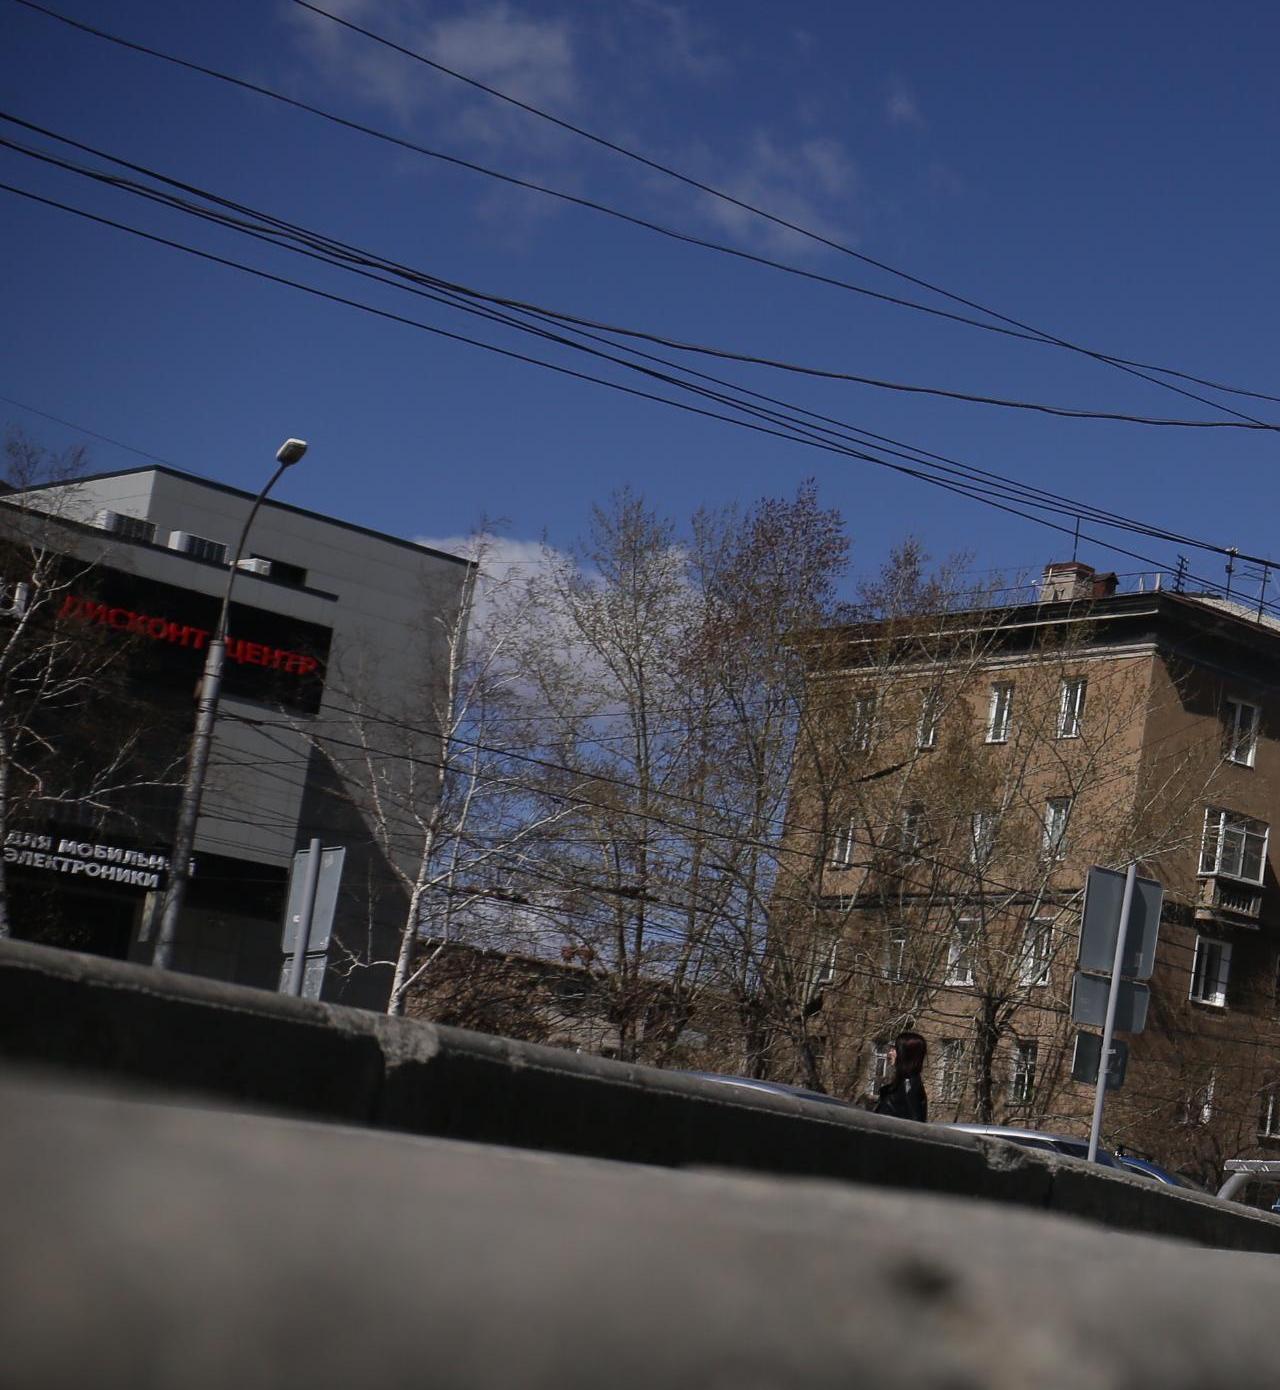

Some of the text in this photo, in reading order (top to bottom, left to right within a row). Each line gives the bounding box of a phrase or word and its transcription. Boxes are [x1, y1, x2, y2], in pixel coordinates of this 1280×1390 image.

[2, 848, 159, 888] ЭЛЕКТРОНИКИ
[3, 830, 199, 876] ДЛЯ МОБИЛЬН
